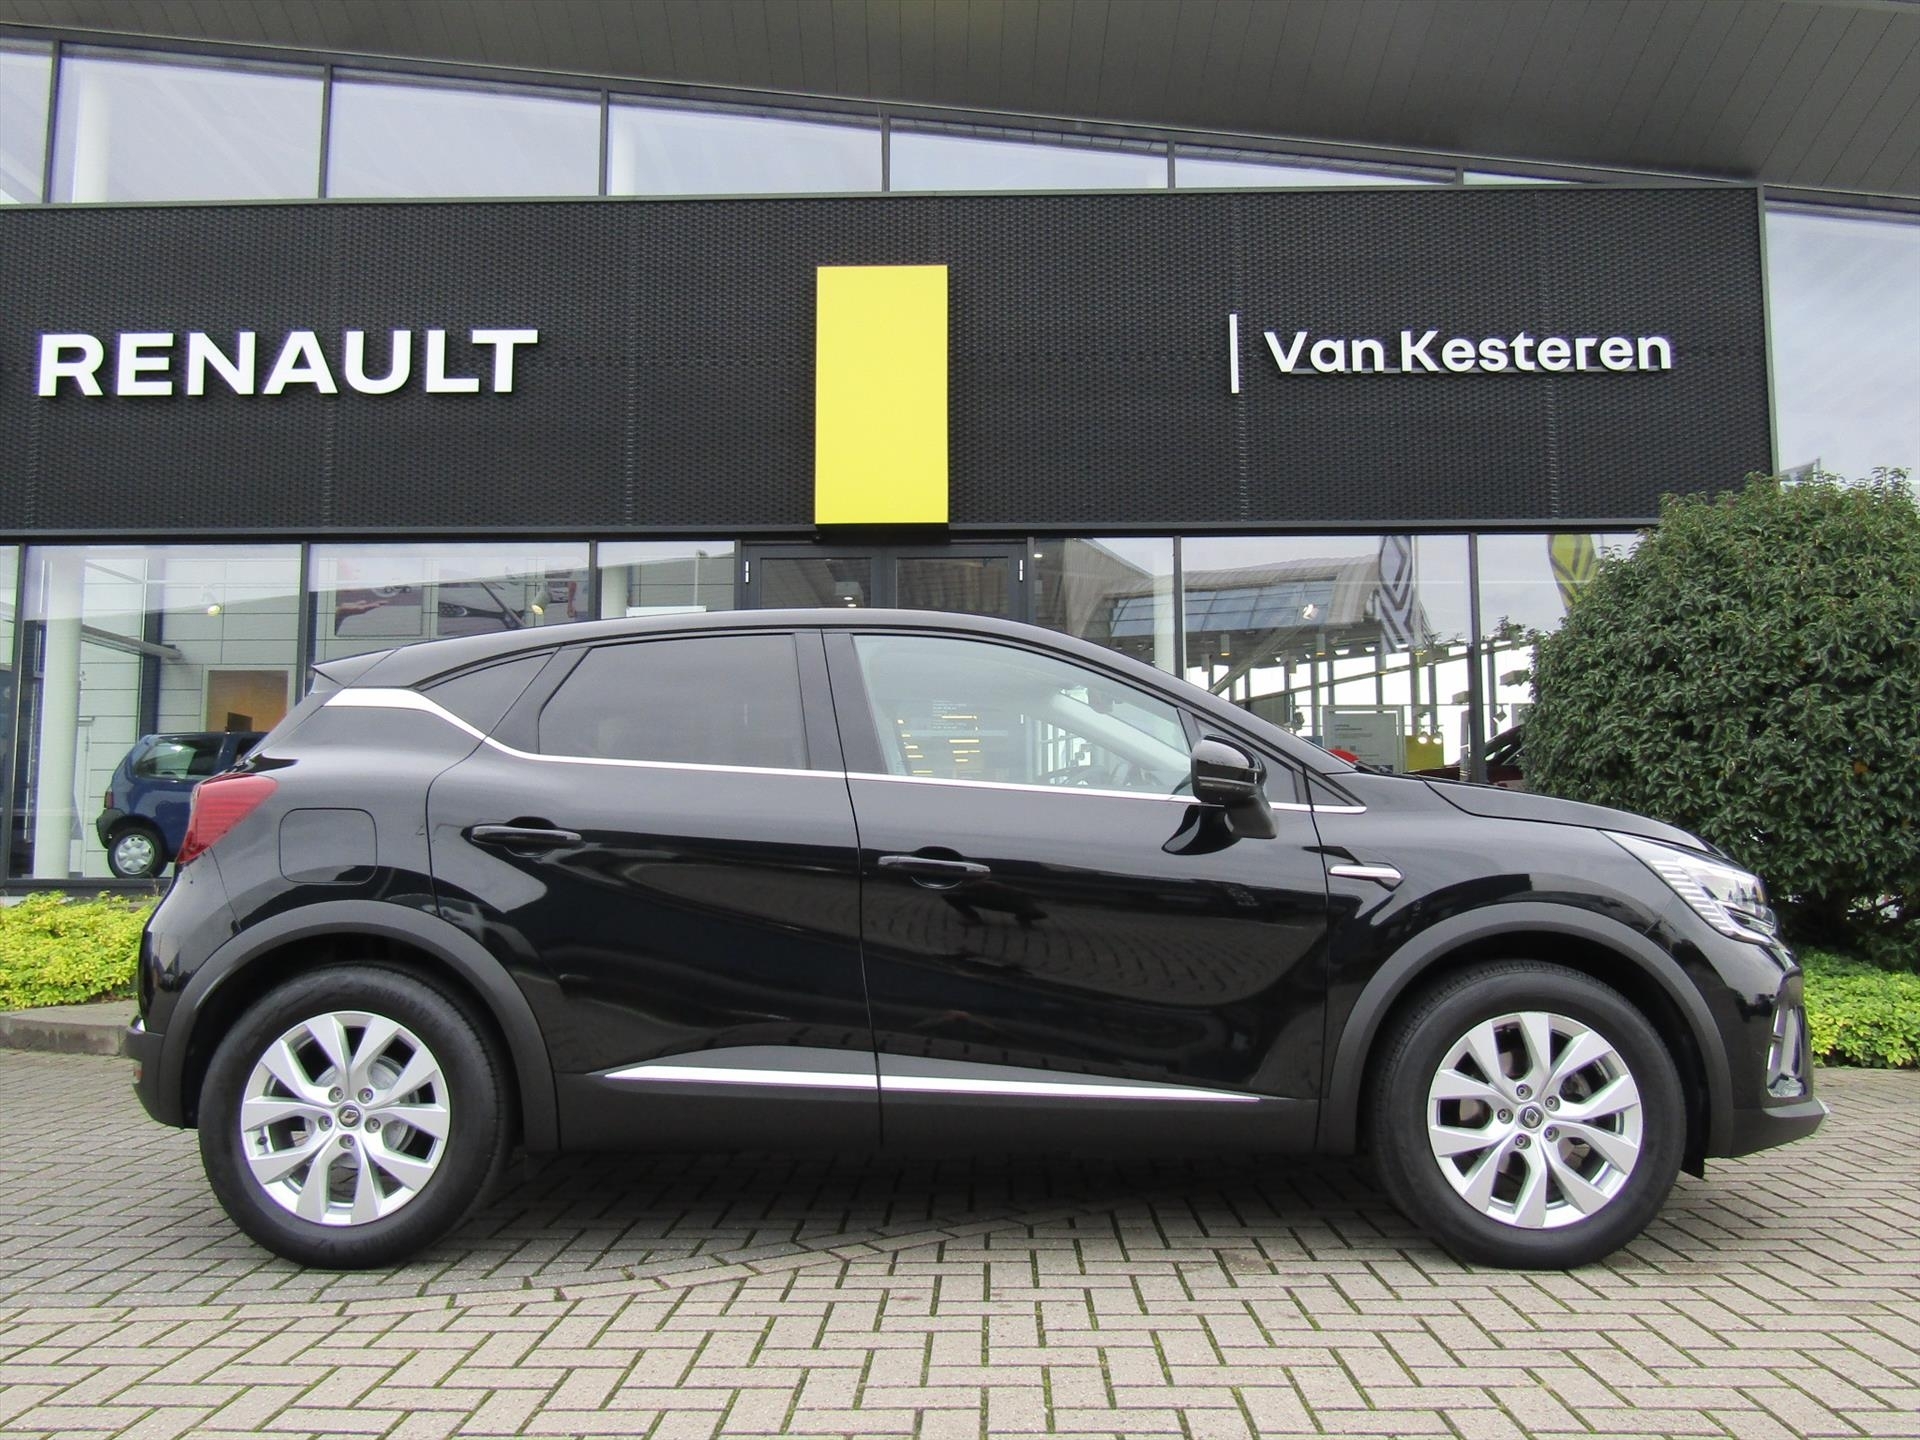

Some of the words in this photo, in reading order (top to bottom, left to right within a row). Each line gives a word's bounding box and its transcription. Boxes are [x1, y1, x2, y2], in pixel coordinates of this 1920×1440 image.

[37, 329, 539, 397] RENAULT
[1263, 331, 1385, 373] Van
[1400, 330, 1672, 372] Kesteren
